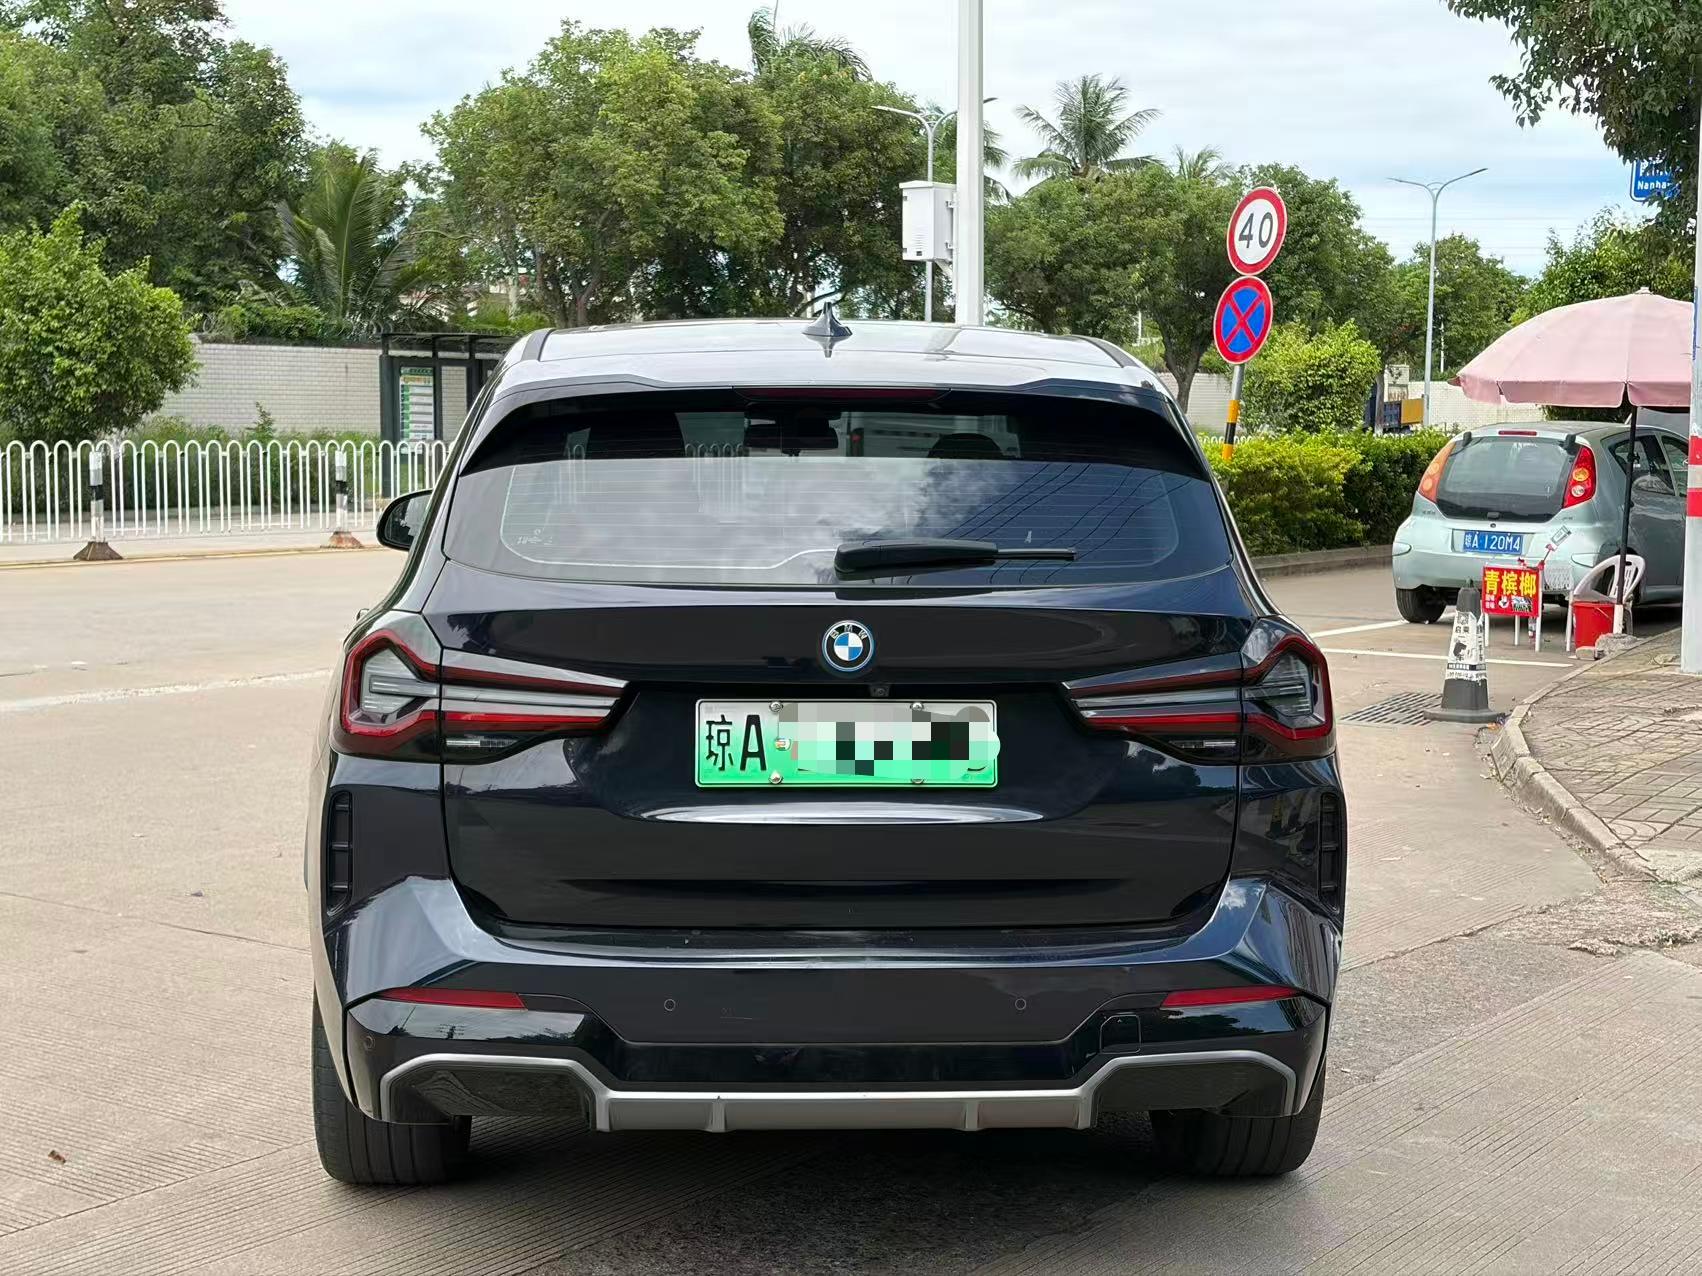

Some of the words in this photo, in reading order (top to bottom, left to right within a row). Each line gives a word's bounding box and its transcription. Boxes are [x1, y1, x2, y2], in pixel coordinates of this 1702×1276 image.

[1637, 180, 1669, 190] Nanha
[1238, 211, 1274, 249] 40
[1484, 569, 1537, 597] 青槟榔
[829, 623, 868, 640] BMW
